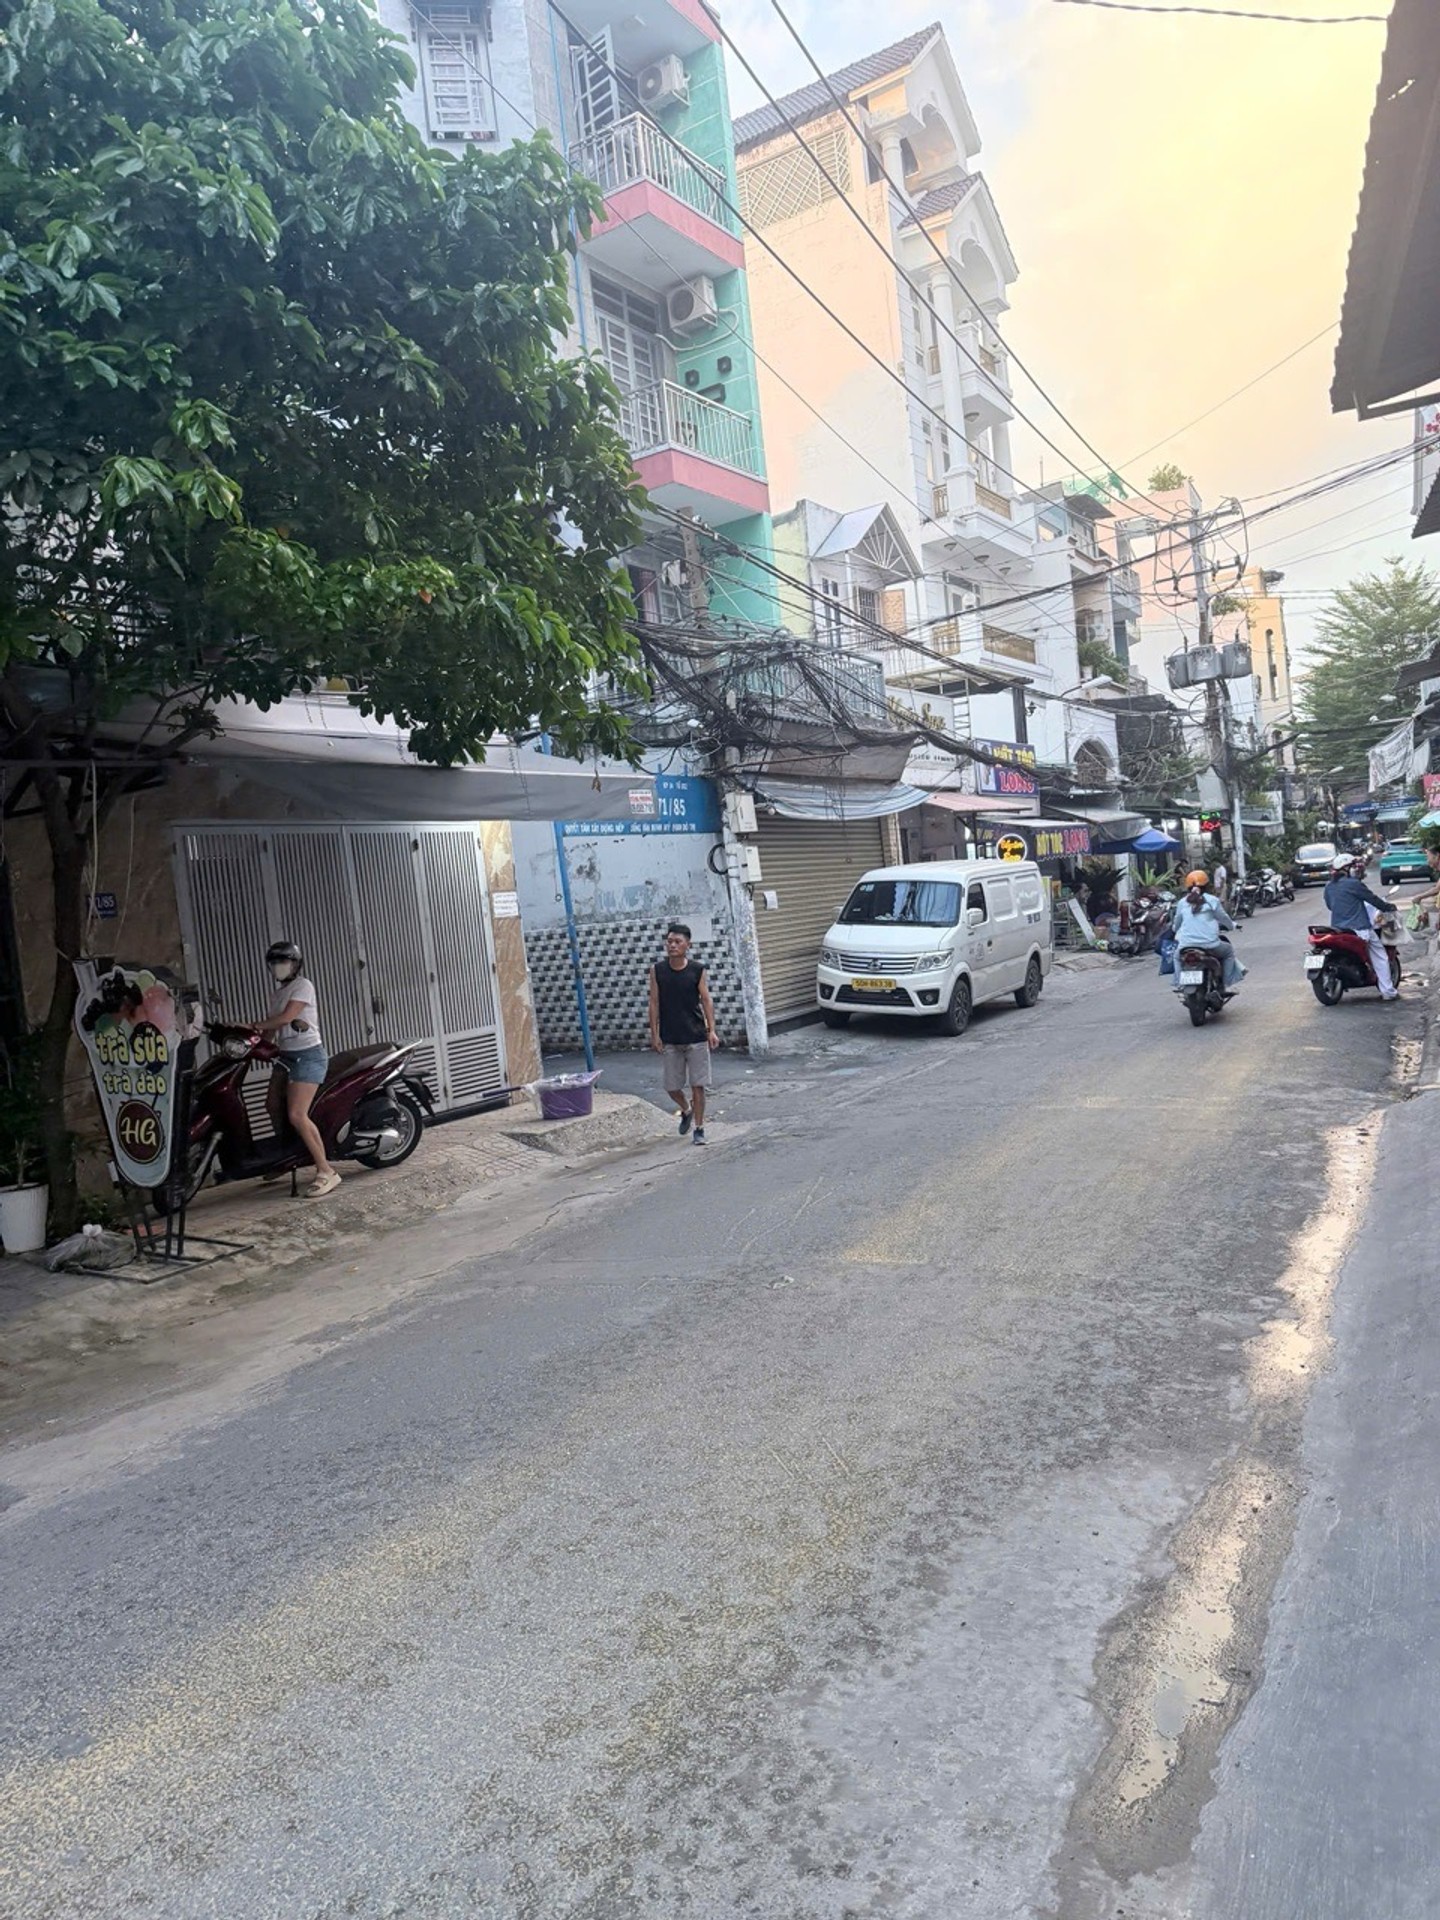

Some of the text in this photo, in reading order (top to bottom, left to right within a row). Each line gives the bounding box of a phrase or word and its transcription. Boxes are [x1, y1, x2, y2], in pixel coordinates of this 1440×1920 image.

[96, 1027, 168, 1065] trà sữa
[103, 1069, 132, 1095] trà
[120, 1117, 157, 1147] HG
